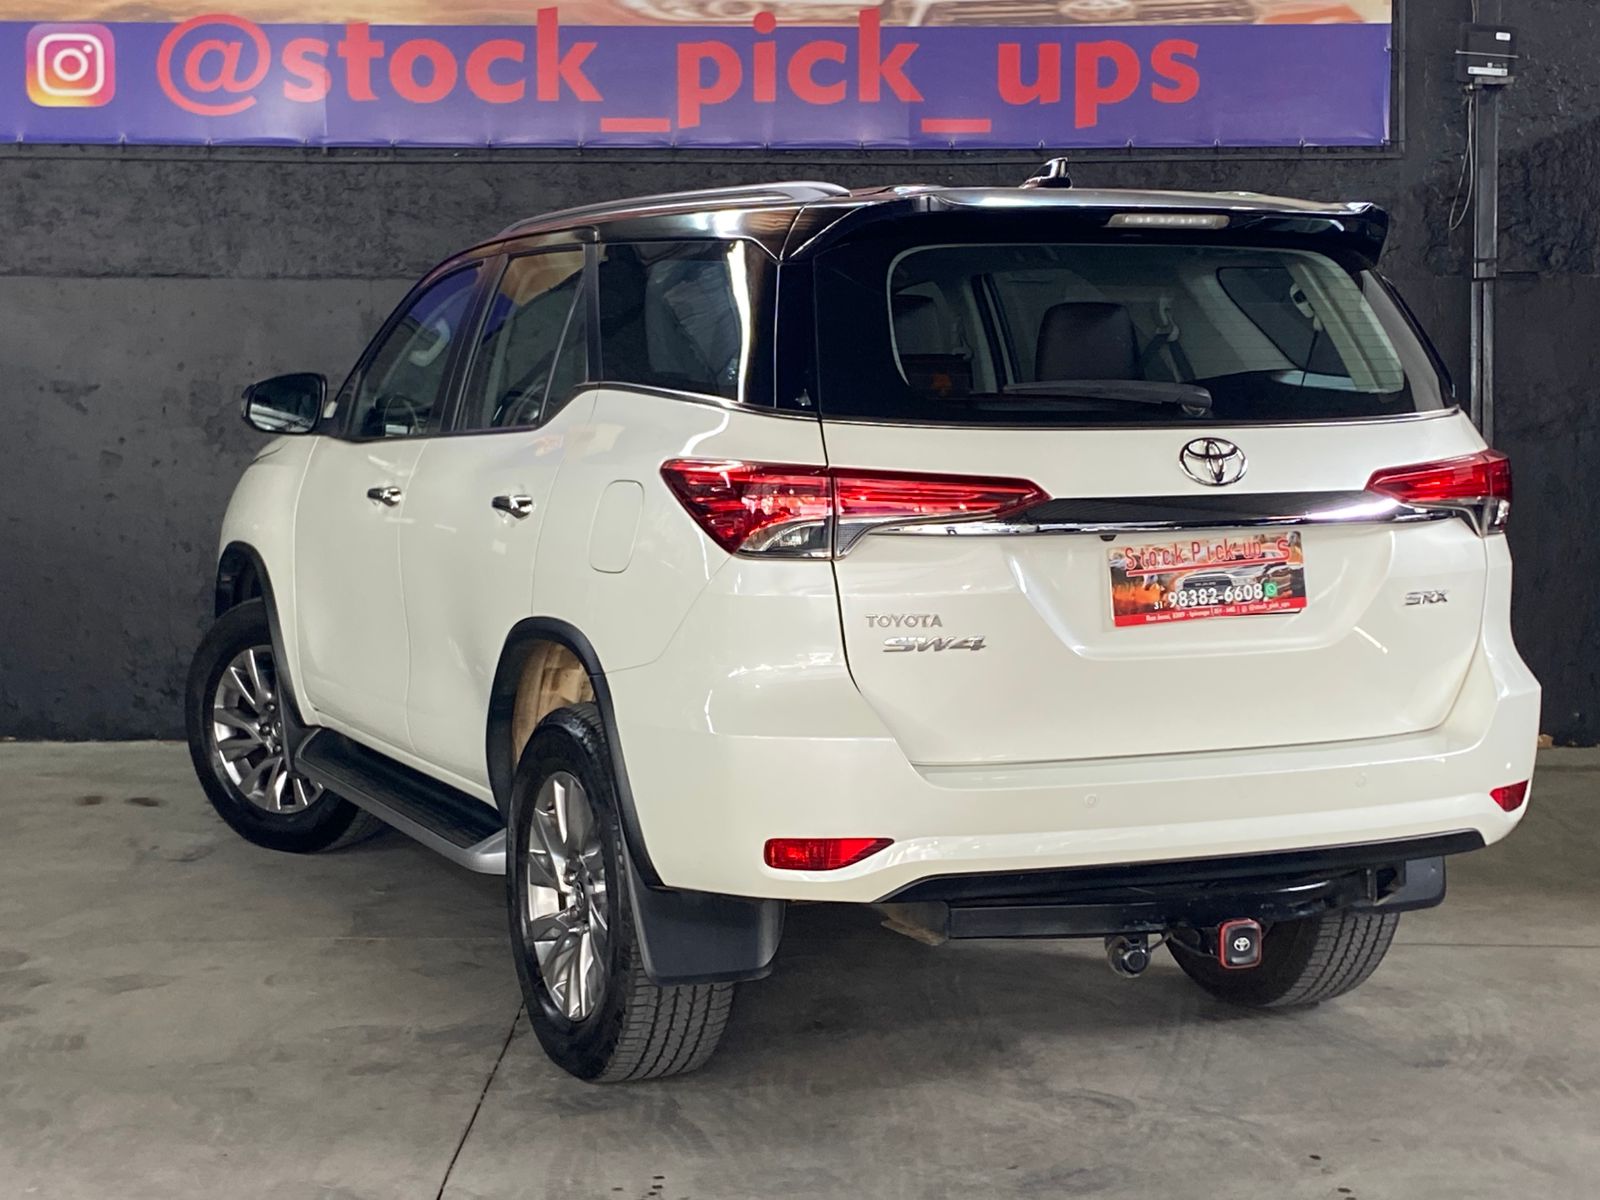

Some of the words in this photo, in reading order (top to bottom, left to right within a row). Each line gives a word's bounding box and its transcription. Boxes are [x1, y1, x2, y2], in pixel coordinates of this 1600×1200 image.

[156, 6, 1199, 133] @stock_pick_ups
[1125, 541, 1184, 571] Stock
[1168, 583, 1264, 608] 98382-6608
[1405, 589, 1449, 606] SRX
[865, 614, 943, 628] TOYOTA
[882, 636, 987, 653] SW4
